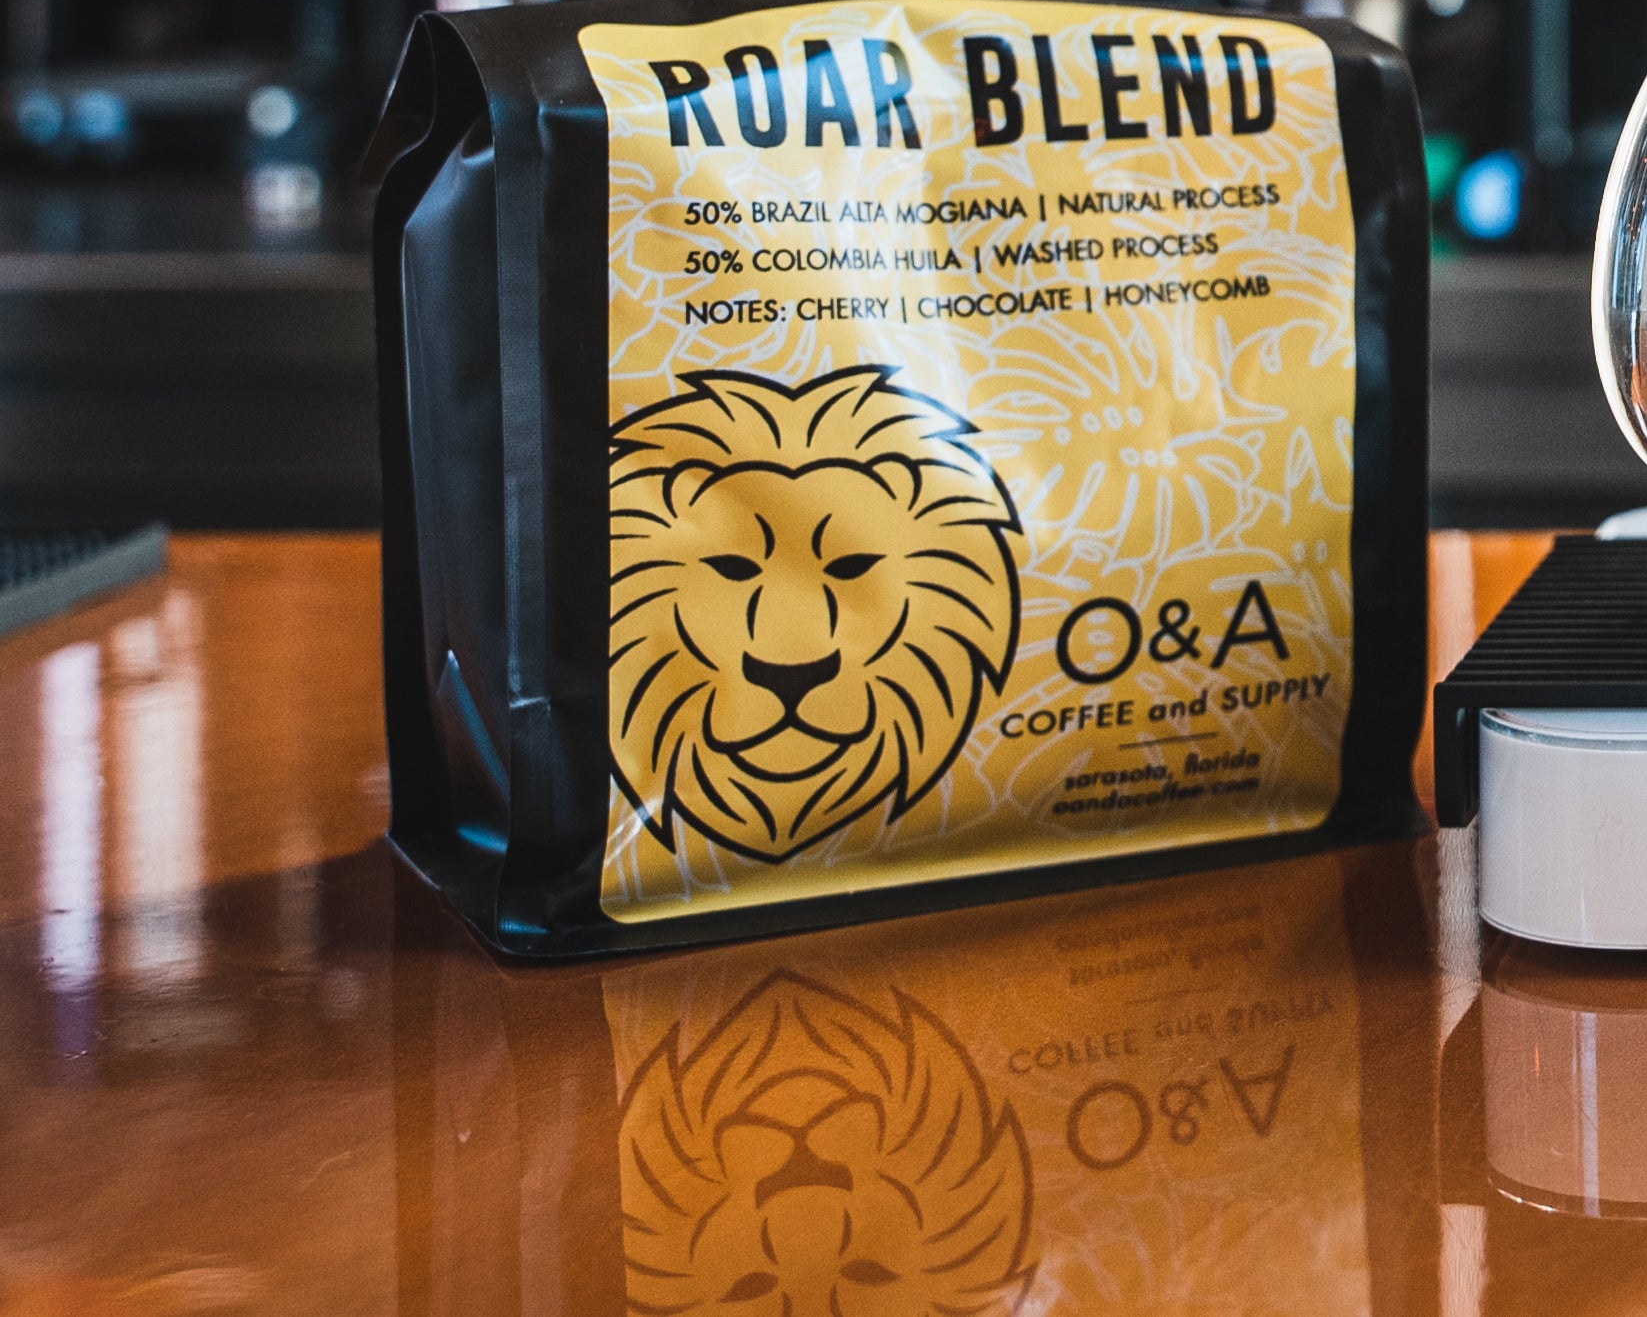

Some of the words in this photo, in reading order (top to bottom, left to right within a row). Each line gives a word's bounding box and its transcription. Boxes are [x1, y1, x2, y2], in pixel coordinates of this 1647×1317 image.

[648, 38, 923, 149] ROAR
[963, 34, 1278, 147] BLEND
[684, 200, 743, 226] 50%
[751, 200, 831, 224] BRAZIL
[839, 200, 888, 224] ALTA
[896, 196, 1028, 225] MOGIANA
[1058, 190, 1165, 215] NATURAL
[1172, 183, 1280, 210] PROCESS
[684, 249, 744, 274] 50%
[752, 248, 887, 272] COLOMBIA
[894, 248, 962, 271] HUILA
[993, 239, 1104, 266] WASHED
[1112, 233, 1219, 259] PROCESS
[685, 298, 788, 325] NOTES:
[796, 296, 890, 321] CHERRY
[918, 287, 1072, 318] CHOCOLATE
[1105, 274, 1271, 307] HONEYCOMB
[1000, 699, 1135, 739] COFFEE
[1148, 691, 1208, 723] and
[1221, 672, 1332, 712] SUPPLY
